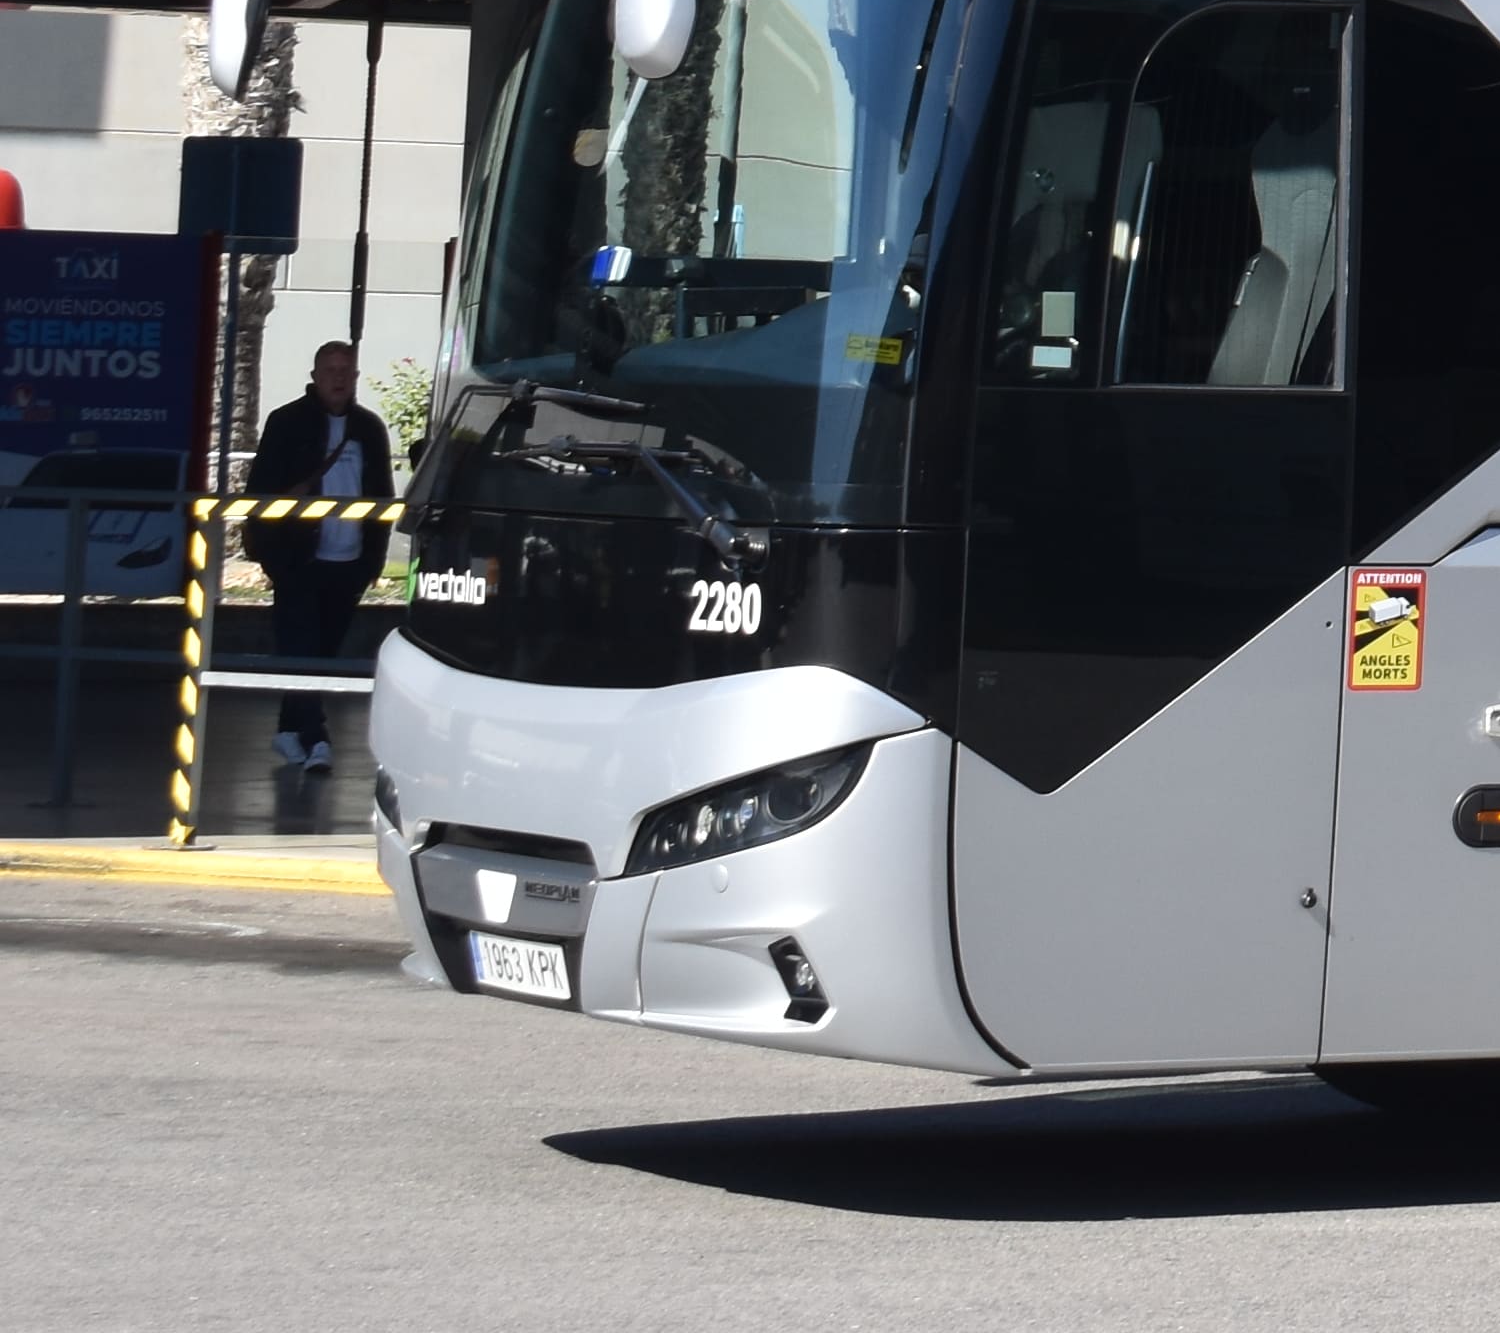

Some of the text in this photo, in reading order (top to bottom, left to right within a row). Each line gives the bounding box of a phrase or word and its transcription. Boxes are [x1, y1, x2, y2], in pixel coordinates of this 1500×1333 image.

[5, 294, 167, 317] MOVIÉNDONOS
[5, 319, 161, 347] SIEMPRE
[2, 348, 162, 379] JUNTOS
[80, 406, 168, 422] 965252511
[1357, 573, 1422, 584] ATTENTION
[689, 580, 762, 635] 2280
[1359, 654, 1411, 667] ANGLES
[1361, 667, 1408, 680] MORTS
[484, 940, 564, 990] 1963 KPK
